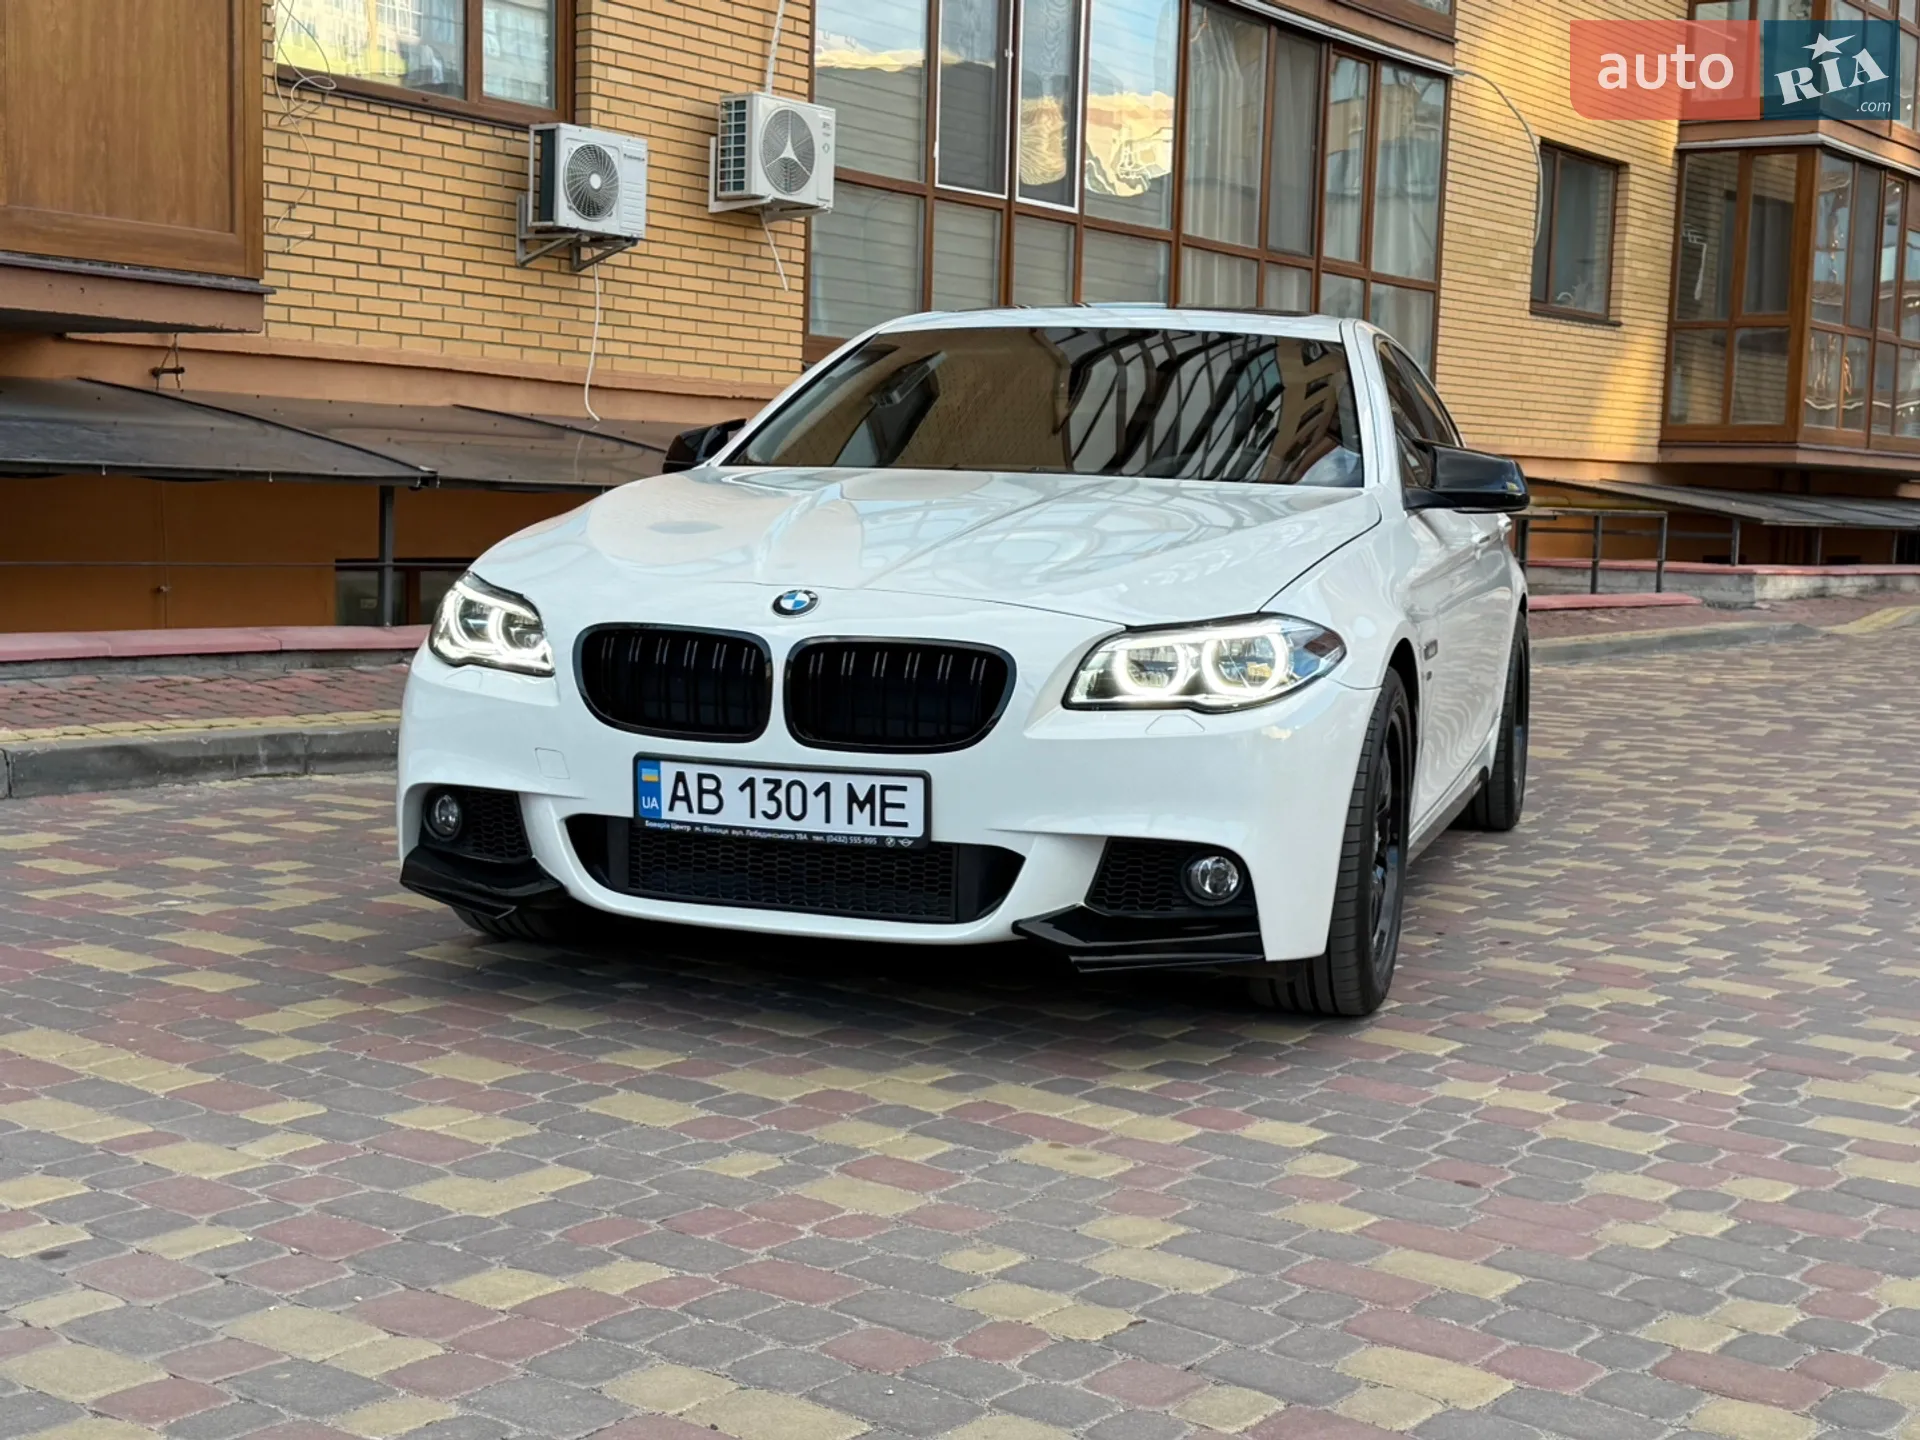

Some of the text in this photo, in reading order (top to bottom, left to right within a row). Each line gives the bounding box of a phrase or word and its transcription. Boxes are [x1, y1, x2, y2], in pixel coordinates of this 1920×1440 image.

[642, 796, 659, 809] UA
[668, 771, 908, 828] AB 1301 ME
[671, 823, 691, 832] Центр
